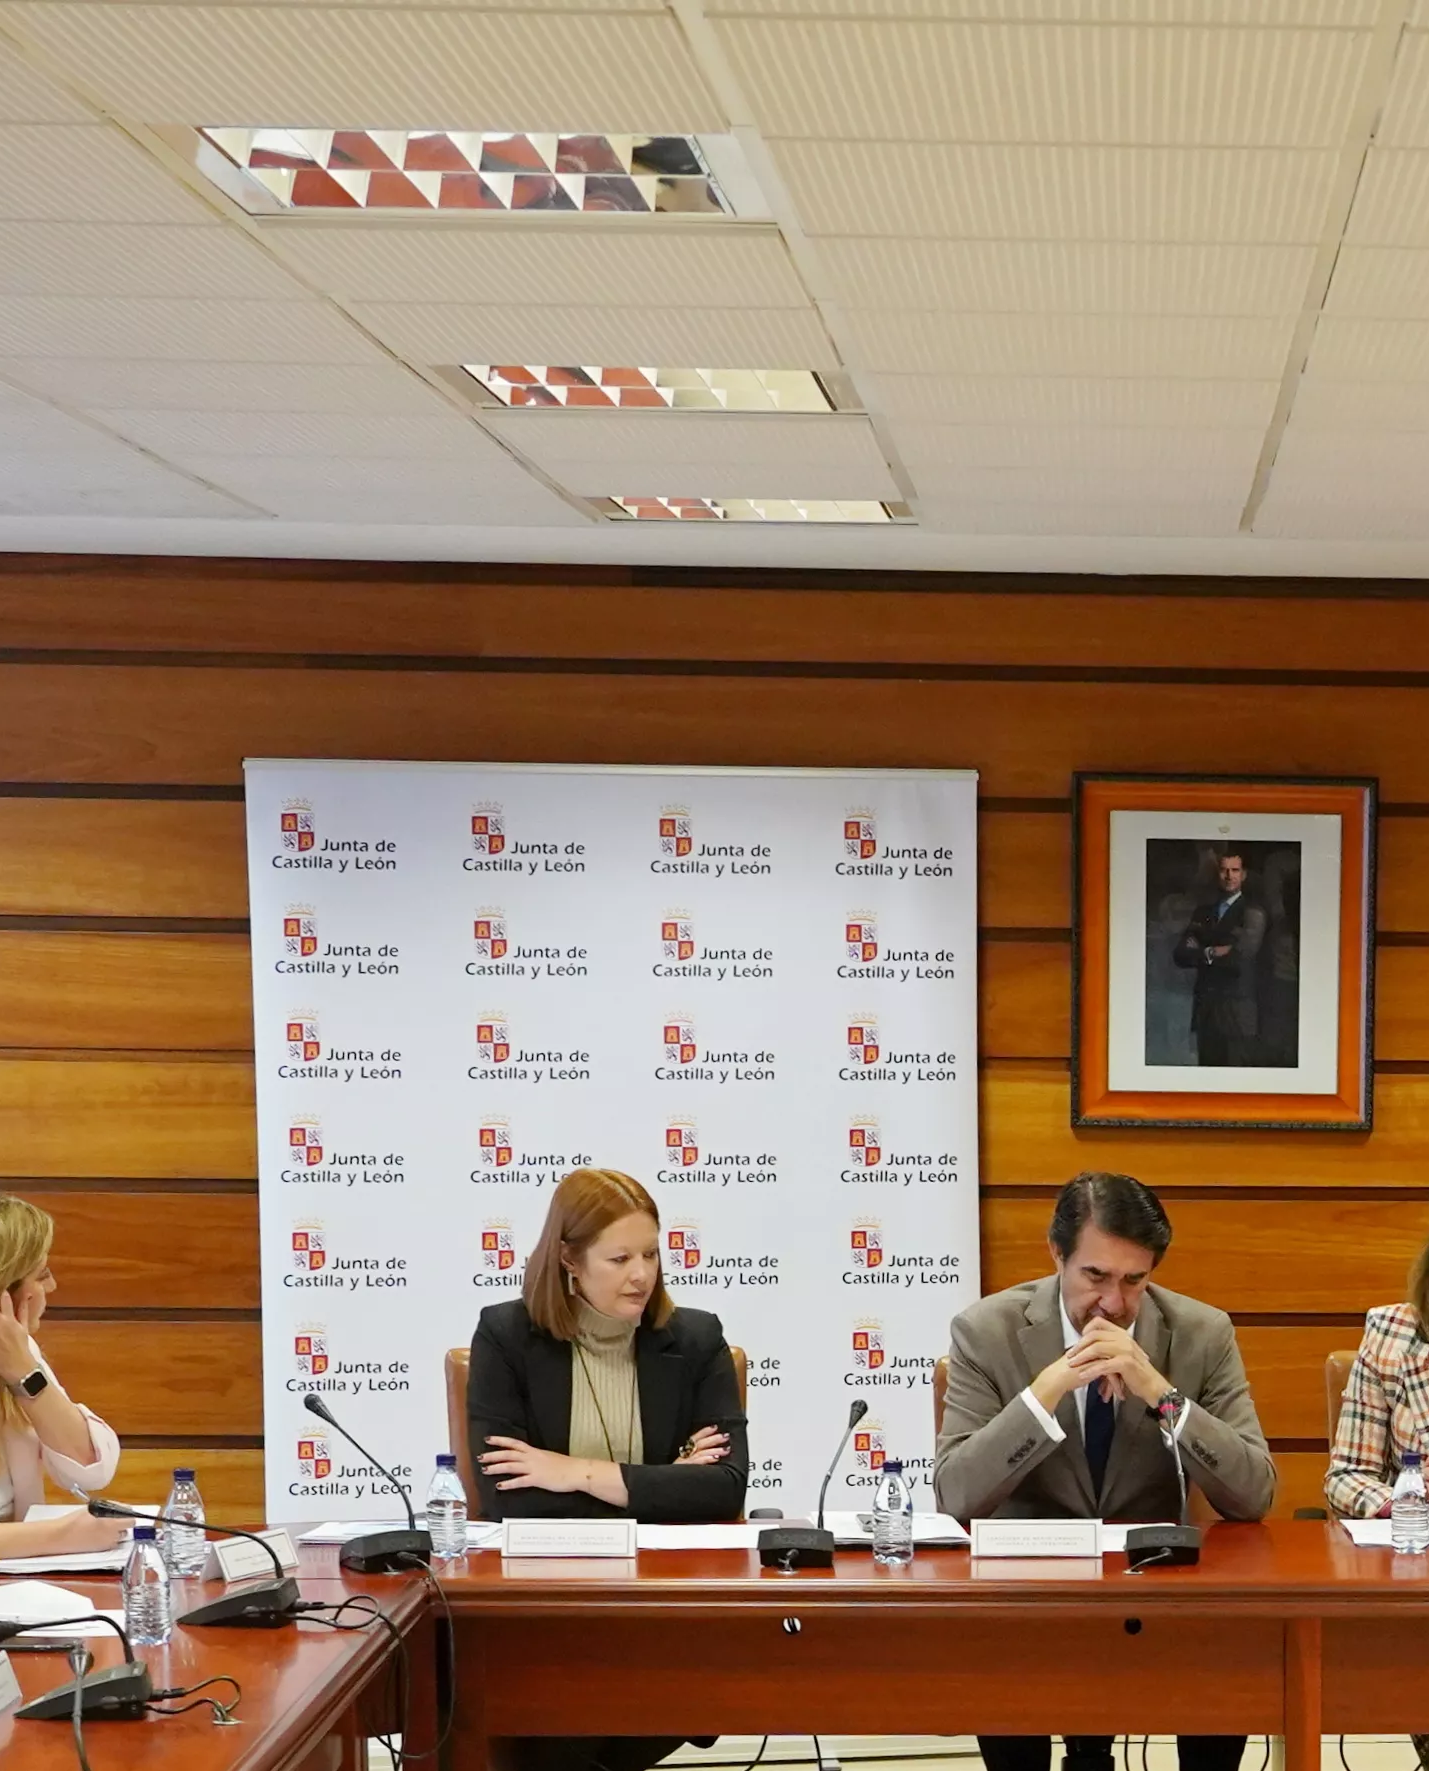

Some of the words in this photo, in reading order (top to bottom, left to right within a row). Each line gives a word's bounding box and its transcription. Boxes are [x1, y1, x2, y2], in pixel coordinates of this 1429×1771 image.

[319, 838, 369, 853] Junta
[374, 839, 397, 853] de
[510, 841, 559, 855] Junta
[563, 841, 586, 856] de
[697, 843, 745, 857] Junta
[750, 844, 772, 858] de
[881, 845, 928, 860] Junta
[932, 846, 954, 861] de
[271, 855, 334, 870] Castilla
[338, 859, 349, 874] y
[354, 856, 397, 871] León
[462, 857, 523, 872] Castilla
[528, 861, 539, 876] y
[544, 858, 586, 873] León
[650, 859, 710, 874] Castilla
[715, 864, 725, 879] y
[731, 860, 771, 875] León
[834, 861, 894, 877] Castilla
[898, 866, 909, 880] y
[914, 863, 954, 878] León
[322, 943, 372, 957] Junta
[377, 944, 399, 958] de
[513, 945, 561, 959] Junta
[566, 945, 588, 959] de
[699, 947, 747, 961] Junta
[752, 947, 773, 961] de
[882, 948, 930, 962] Junta
[934, 949, 955, 963] de
[274, 960, 336, 974] Castilla
[341, 963, 352, 979] y
[357, 961, 399, 975] León
[464, 962, 525, 976] Castilla
[530, 965, 541, 980] y
[546, 962, 588, 977] León
[652, 963, 712, 978] Castilla
[717, 967, 727, 982] y
[733, 964, 773, 978] León
[836, 964, 895, 979] Castilla
[899, 968, 911, 983] y
[915, 965, 955, 980] León
[325, 1047, 374, 1062] Junta
[380, 1048, 402, 1062] de
[515, 1049, 563, 1063] Junta
[568, 1049, 590, 1063] de
[701, 1050, 749, 1064] Junta
[754, 1050, 775, 1064] de
[884, 1051, 931, 1064] Junta
[936, 1051, 957, 1065] de
[277, 1065, 339, 1079] Castilla
[344, 1068, 355, 1083] y
[360, 1065, 402, 1080] León
[467, 1066, 528, 1080] Castilla
[533, 1069, 543, 1084] y
[549, 1066, 590, 1080] León
[654, 1066, 714, 1081] Castilla
[718, 1070, 730, 1085] y
[735, 1066, 775, 1081] León
[838, 1067, 897, 1081] Castilla
[901, 1071, 912, 1085] y
[917, 1067, 957, 1082] León
[328, 1152, 377, 1166] Junta
[382, 1153, 405, 1166] de
[517, 1152, 566, 1166] Junta
[571, 1152, 593, 1166] de
[703, 1153, 751, 1166] Junta
[756, 1152, 777, 1166] de
[885, 1153, 933, 1166] Junta
[937, 1152, 958, 1166] de
[280, 1169, 342, 1184] Castilla
[346, 1173, 357, 1188] y
[362, 1169, 405, 1184] León
[469, 1170, 530, 1184] Castilla
[535, 1173, 546, 1188] y
[656, 1169, 716, 1184] Castilla
[721, 1173, 731, 1187] y
[737, 1169, 777, 1184] León
[840, 1169, 898, 1184] Castilla
[903, 1172, 913, 1187] y
[918, 1169, 958, 1183] León
[331, 1256, 380, 1270] Junta
[385, 1256, 407, 1270] de
[705, 1255, 753, 1269] Junta
[758, 1255, 779, 1269] de
[887, 1254, 934, 1268] Junta
[939, 1254, 960, 1267] de
[282, 1274, 344, 1288] Castilla
[349, 1277, 360, 1292] y
[365, 1273, 407, 1288] León
[472, 1273, 523, 1288] Castill
[723, 1275, 734, 1290] y
[739, 1271, 779, 1286] León
[841, 1271, 900, 1285] Castilla
[904, 1274, 915, 1289] y
[920, 1270, 960, 1285] León
[333, 1360, 382, 1375] Junta
[387, 1360, 410, 1374] de
[760, 1357, 781, 1370] de
[889, 1355, 936, 1369] Junta
[285, 1378, 347, 1392] Castilla
[351, 1381, 363, 1396] y
[368, 1377, 410, 1392] León
[746, 1373, 781, 1387] eón
[843, 1372, 901, 1386] Castilla
[906, 1375, 916, 1390] y
[761, 1459, 783, 1472] de
[895, 1456, 935, 1469] unta
[390, 1464, 413, 1477] de
[908, 1475, 918, 1489] y
[288, 1482, 350, 1497] Castilla
[354, 1484, 365, 1499] y
